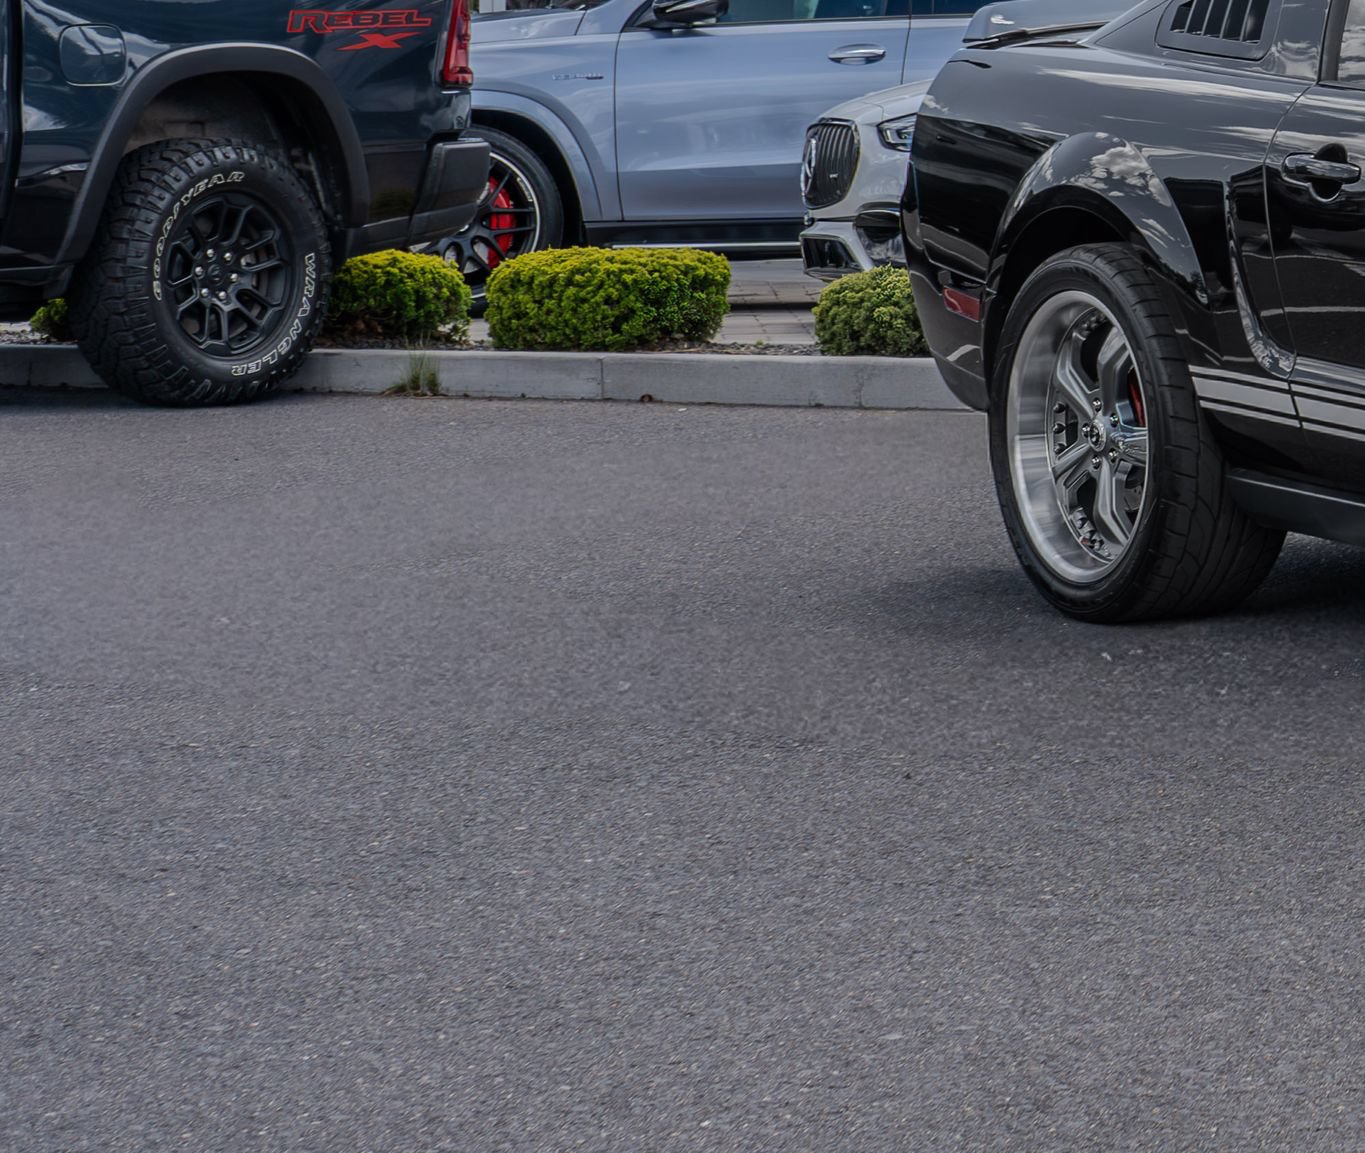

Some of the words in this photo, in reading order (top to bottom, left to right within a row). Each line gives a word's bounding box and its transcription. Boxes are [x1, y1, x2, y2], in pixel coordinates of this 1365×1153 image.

[287, 9, 432, 33] REBEL
[336, 31, 423, 51] X
[231, 252, 316, 376] WRANGLER
